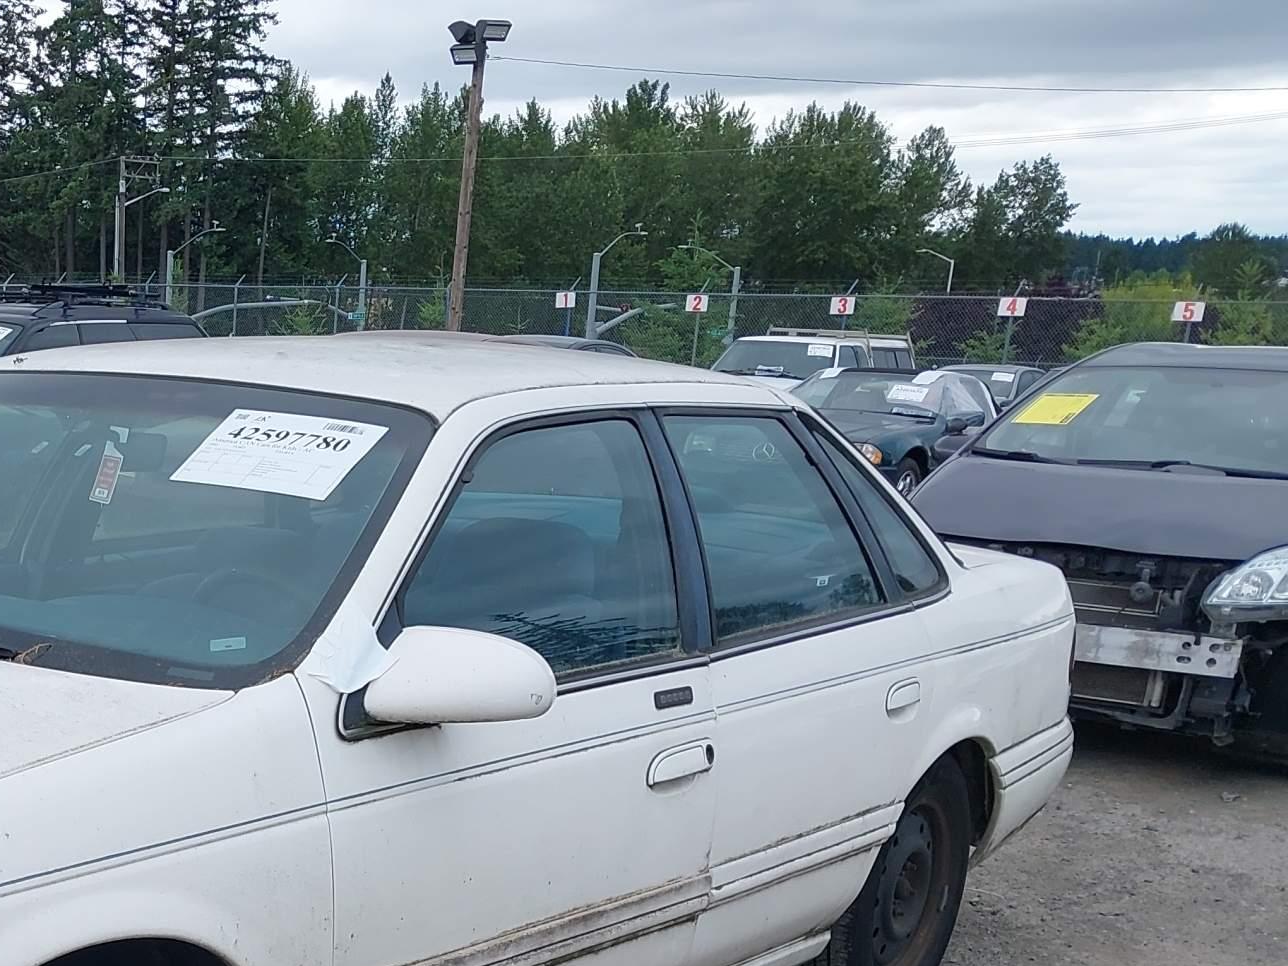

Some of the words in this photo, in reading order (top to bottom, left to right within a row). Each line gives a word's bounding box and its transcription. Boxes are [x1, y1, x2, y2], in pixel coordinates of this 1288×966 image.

[562, 293, 568, 307] 1
[692, 296, 702, 310] 2
[837, 298, 848, 313] 3
[1006, 299, 1017, 315] 4
[1182, 302, 1196, 320] 5
[228, 426, 351, 453] 42597780
